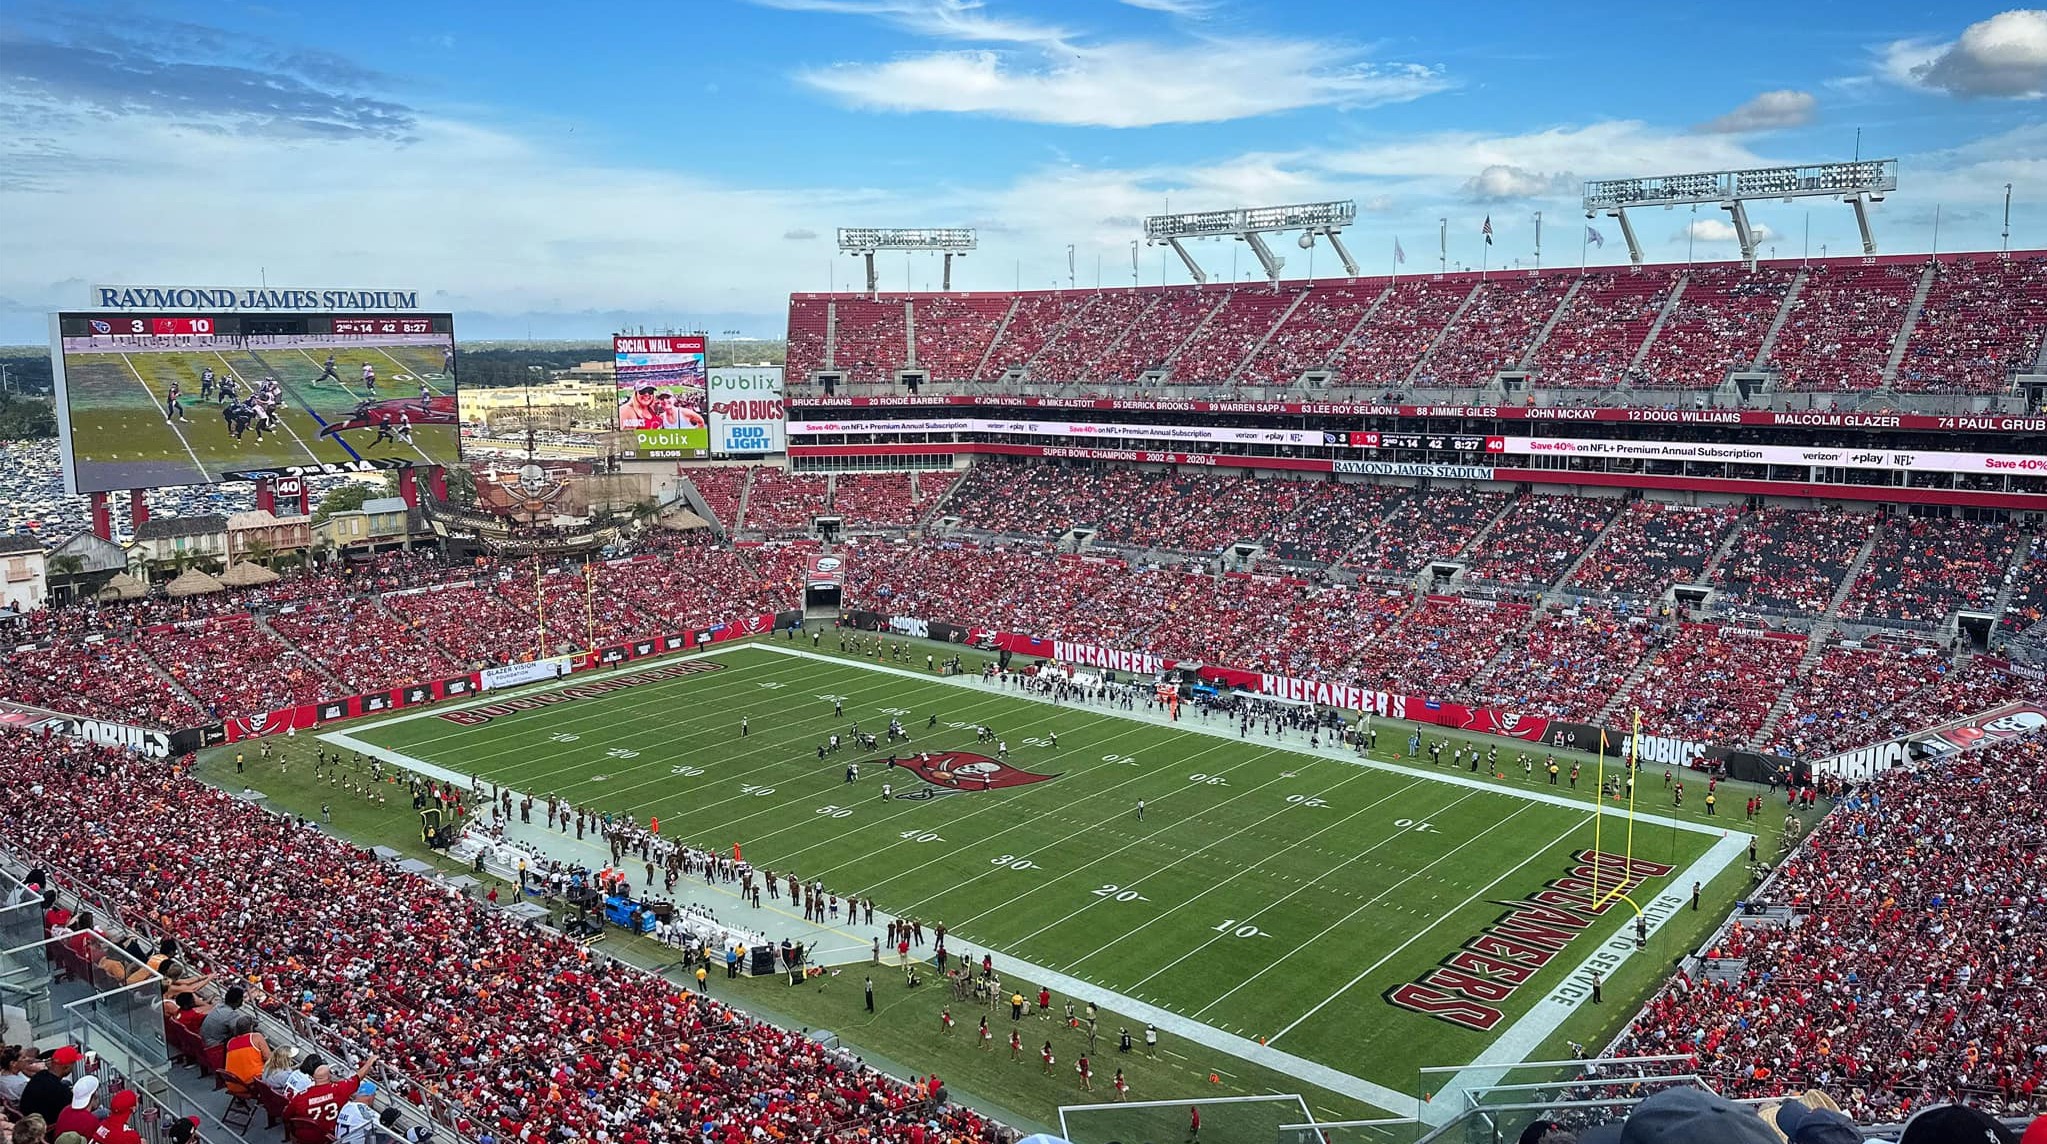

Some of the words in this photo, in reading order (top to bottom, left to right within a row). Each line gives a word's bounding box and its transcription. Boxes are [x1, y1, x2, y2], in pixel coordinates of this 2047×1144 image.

[100, 288, 236, 307] RAYMOND
[241, 290, 318, 308] JAMES
[323, 291, 416, 308] STADIUM
[131, 320, 143, 333] 3
[189, 320, 209, 332] 10
[404, 324, 426, 332] 8:27
[617, 339, 647, 352] SOCIAL
[649, 339, 672, 352] WALL
[712, 375, 774, 390] Publix
[792, 398, 819, 406] BRUCE
[822, 398, 852, 406] ARIANS
[1064, 400, 1095, 408] ALSTOTT
[1123, 401, 1154, 409] DERRICK
[1157, 402, 1188, 410] BROOKS
[1220, 403, 1255, 411] WARREN
[1257, 404, 1279, 412] SAPP
[730, 400, 747, 420] GO
[749, 400, 784, 420] BUCS
[1332, 406, 1352, 414] ROY
[1353, 406, 1392, 415] SELMON
[1417, 407, 1428, 415] 88
[1430, 407, 1463, 416] JIMMIE
[1466, 408, 1497, 417] GILES
[1525, 409, 1555, 418] JOHN
[1558, 410, 1596, 419] MCKAY
[1628, 411, 1640, 420] 12
[1644, 412, 1678, 421] DOUG
[1681, 413, 1741, 422] WILLIAMS
[1775, 414, 1840, 425] MALCOLM
[1845, 416, 1900, 427] GLAZER
[926, 422, 967, 430] Subscription
[1938, 418, 1954, 428] 74
[1959, 419, 1997, 429] PAUL
[2001, 419, 2047, 430] GRUB
[732, 427, 764, 437] BUD
[1172, 429, 1211, 438] Subscription
[638, 434, 687, 445] Publix
[727, 438, 770, 449] LIGHT
[1339, 434, 1346, 442] 3
[1366, 435, 1377, 443] 10
[1429, 440, 1442, 448] 42
[1454, 441, 1479, 449] 8:27
[1488, 441, 1502, 449] 40
[1043, 448, 1067, 456] SUPER
[1069, 449, 1090, 458] BOWL
[1092, 450, 1137, 460] CHAMPIONS
[1531, 442, 1552, 450] Save
[1554, 442, 1576, 451] 40%
[1591, 444, 1615, 452] NFL+
[1617, 445, 1659, 454] Premium
[1662, 447, 1695, 455] Annual
[1698, 448, 1762, 458] Subscription
[1146, 454, 1164, 462] 2002
[1187, 455, 1205, 463] 2020
[1803, 452, 1838, 460] verizon
[1986, 459, 2016, 468] Save
[1334, 462, 1392, 473] RAYMOND
[1394, 465, 1433, 476] JAMES
[1437, 467, 1491, 478] STADIUM
[279, 481, 298, 492] 40
[486, 668, 512, 677] GLAZER
[515, 662, 536, 671] VISION
[1286, 794, 1327, 807] 20
[816, 805, 853, 818] 50
[1394, 818, 1434, 832] 10
[899, 830, 938, 843] 40
[991, 854, 1032, 870] 30
[1091, 885, 1138, 902] 20
[1212, 919, 1259, 937] 10
[1388, 848, 1678, 1031] BUCCANEERS
[1551, 952, 1620, 1006] SERVICE
[308, 1103, 338, 1121] 73
